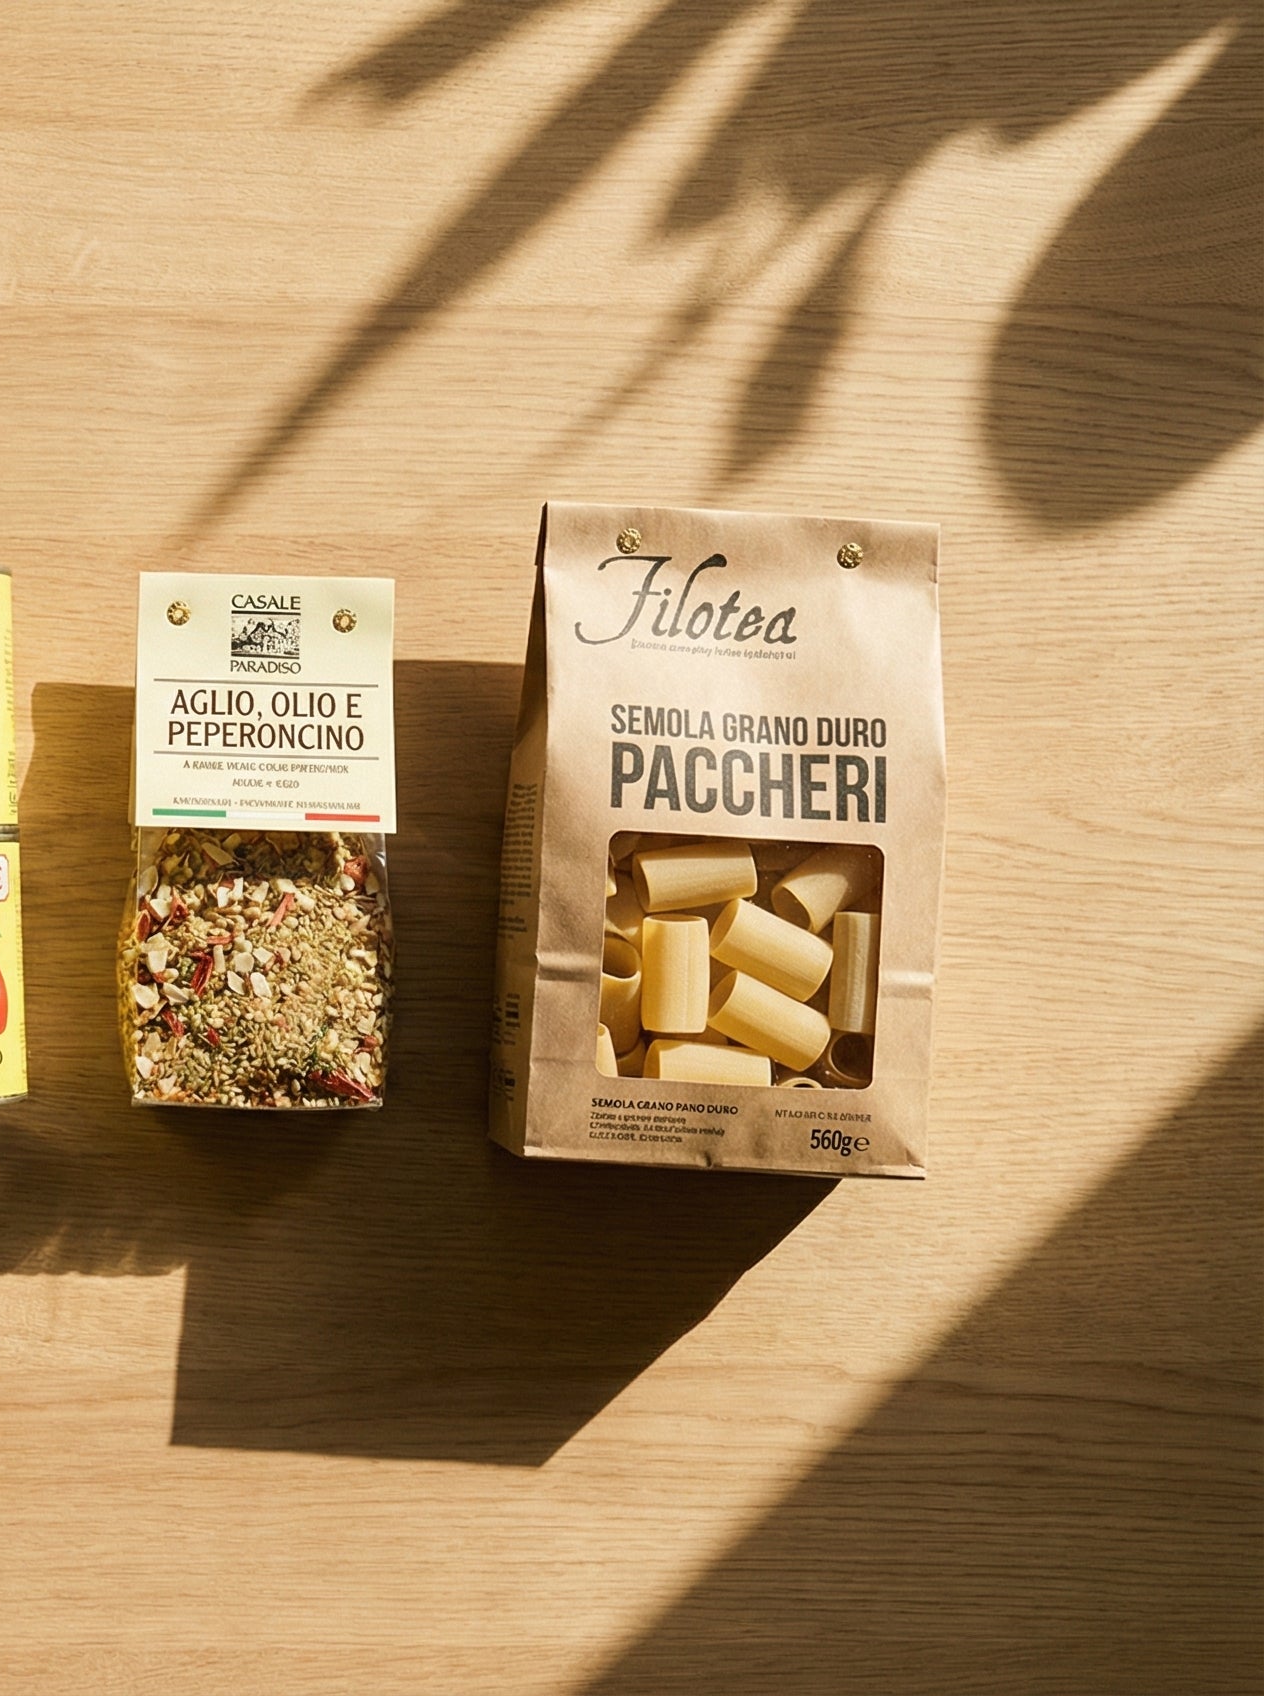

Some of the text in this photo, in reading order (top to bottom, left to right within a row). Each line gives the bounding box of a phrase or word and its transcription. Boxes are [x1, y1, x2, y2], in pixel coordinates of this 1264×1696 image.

[231, 594, 302, 610] CASALE
[575, 552, 797, 646] Filotea
[230, 660, 302, 675] PARADISO
[170, 689, 363, 721] AGLIO, OLIO E
[168, 720, 365, 751] PEPERONCINO
[611, 703, 887, 748] SEMOLA GRANO DURO
[610, 741, 887, 823] PACCHERI
[591, 1097, 635, 1109] SEMOLA
